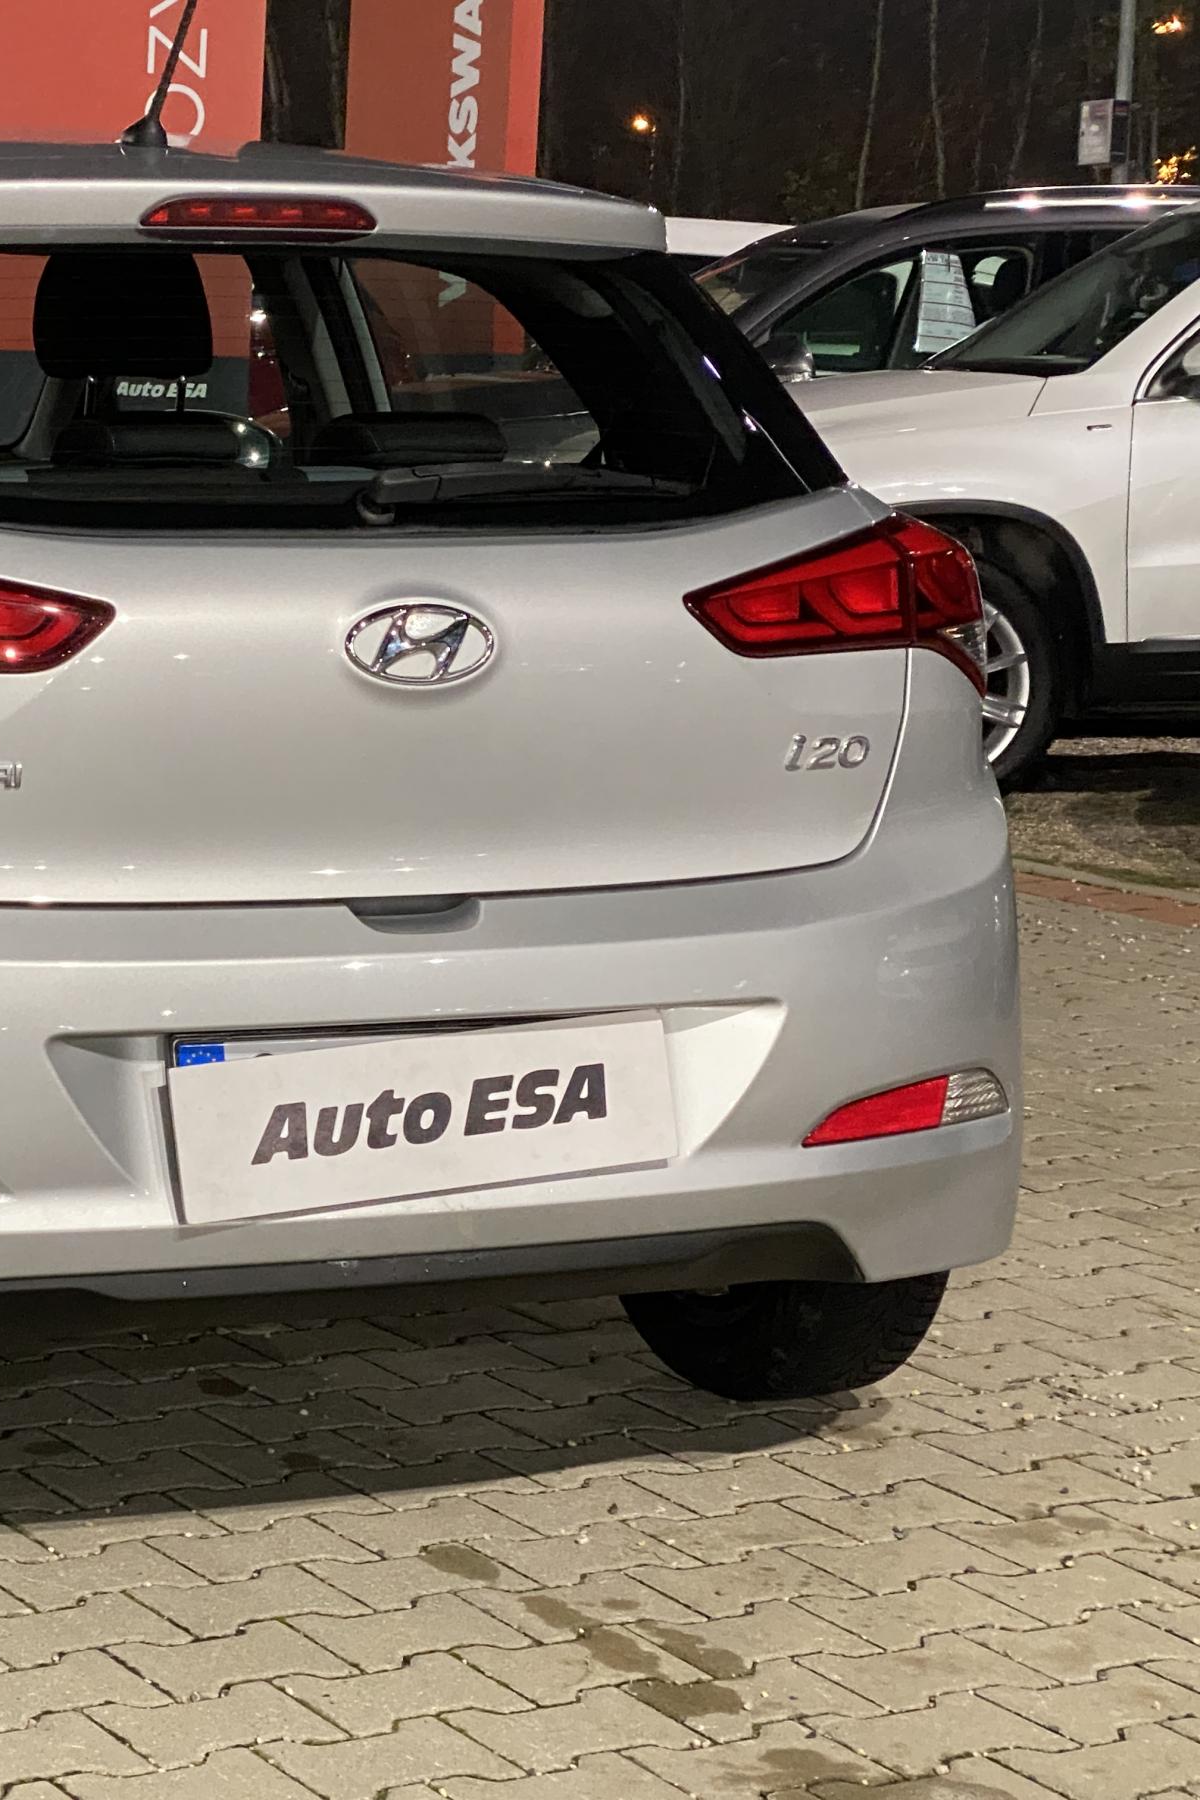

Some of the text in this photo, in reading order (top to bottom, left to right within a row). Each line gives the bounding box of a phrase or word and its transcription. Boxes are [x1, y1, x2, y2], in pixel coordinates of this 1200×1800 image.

[116, 381, 165, 398] Auto
[251, 1063, 607, 1166] Auto ESA
